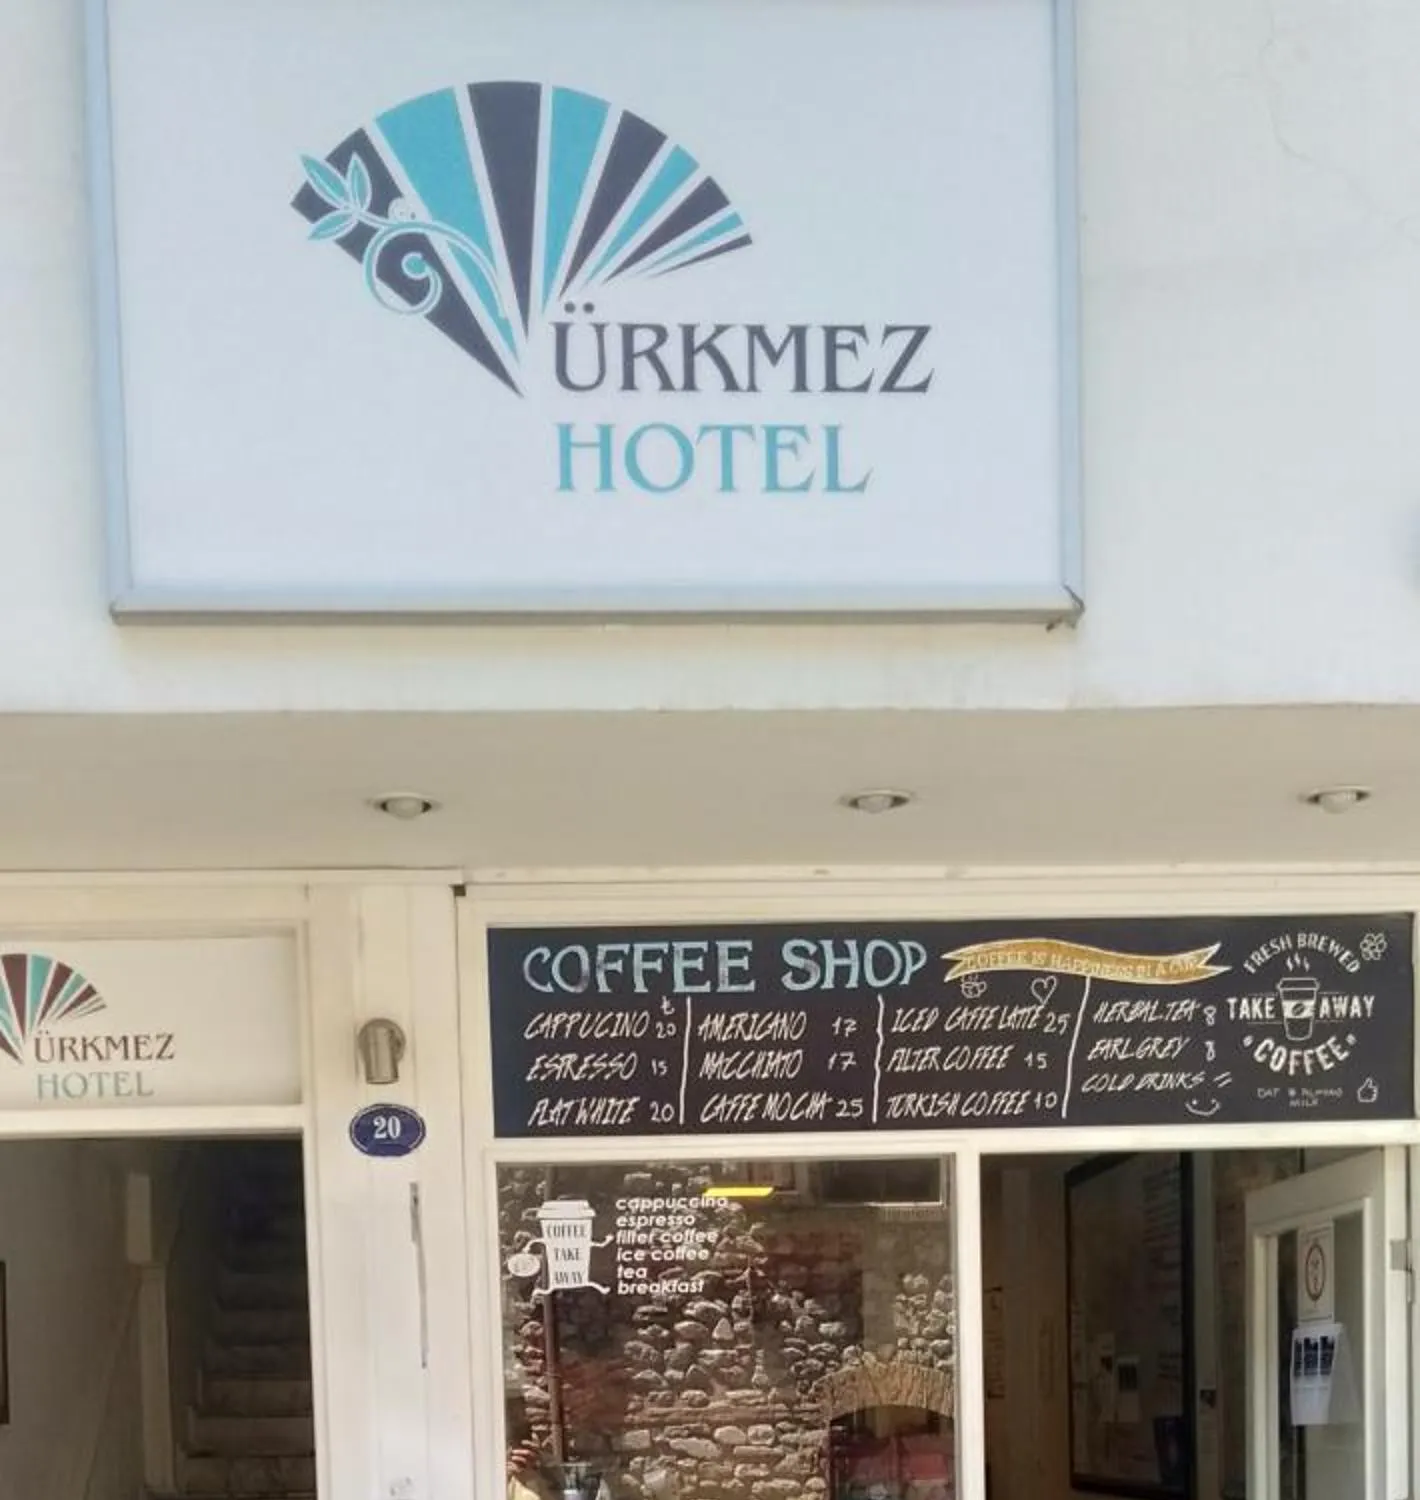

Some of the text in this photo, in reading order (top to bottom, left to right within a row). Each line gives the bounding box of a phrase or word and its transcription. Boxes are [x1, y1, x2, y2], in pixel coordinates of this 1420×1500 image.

[550, 301, 934, 394] ÜRKMEZ
[554, 422, 874, 493] HOTEL
[523, 938, 928, 994] COFFEE SHOP
[1243, 932, 1361, 974] FRESH BREWED
[891, 1006, 940, 1033] ICED
[1043, 1011, 1071, 1036] 25
[1203, 1004, 1217, 1026] 8
[1227, 995, 1375, 1020] TAKE AWAY
[523, 1010, 677, 1040] CAPPUCINO 20
[698, 1010, 807, 1042] AMERICANO
[34, 1030, 175, 1063] ÜRKMEZ
[885, 1044, 1048, 1073] FILTER COFFEE 15
[1087, 1037, 1134, 1061] EARL
[1135, 1035, 1191, 1061] GREY
[1254, 1035, 1349, 1075] COFFEE
[525, 1051, 668, 1081] ESPRESSO 15
[699, 1048, 857, 1080] MACCHIATO 17
[37, 1071, 154, 1099] HOTEL
[1081, 1070, 1206, 1093] COLD DRINKS
[527, 1095, 675, 1127] FLAT WHITE 20
[700, 1090, 864, 1123] CAFFE MOCHA 25
[885, 1090, 1058, 1119] TURKISH COFFEE 10
[373, 1116, 402, 1140] 20
[615, 1196, 729, 1213] cappuccino
[546, 1223, 586, 1238] COFFEE
[615, 1213, 696, 1229] espresso
[659, 1230, 719, 1244] coffee
[554, 1247, 581, 1261] TAKE
[617, 1246, 710, 1262] ice coffee
[617, 1263, 648, 1279] tea
[617, 1279, 704, 1295] breakfast
